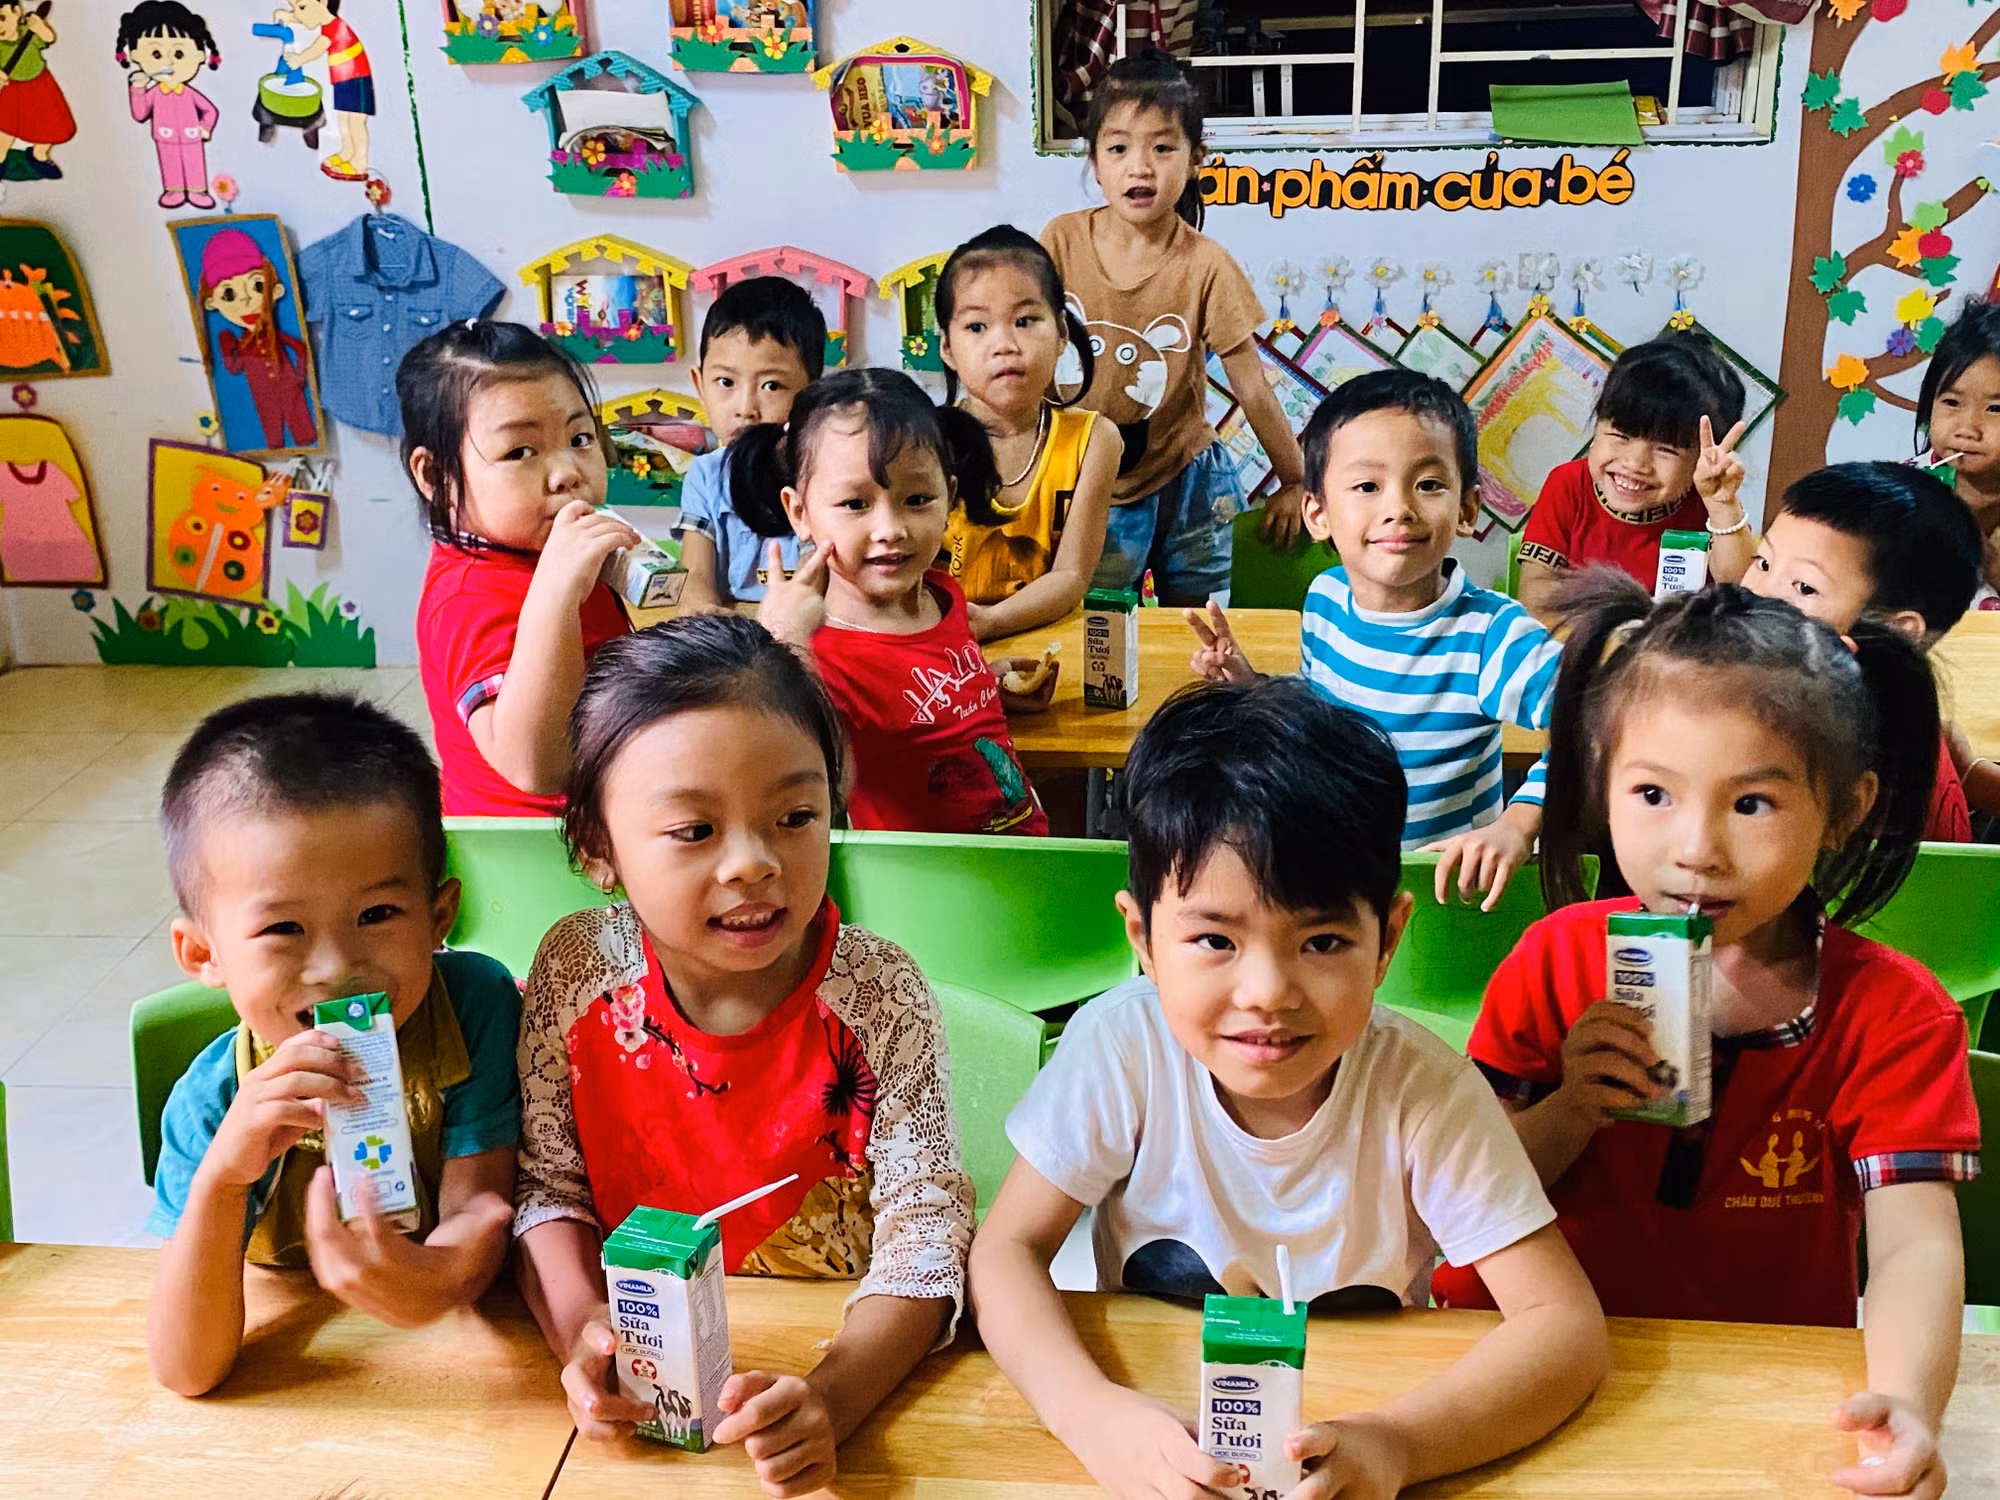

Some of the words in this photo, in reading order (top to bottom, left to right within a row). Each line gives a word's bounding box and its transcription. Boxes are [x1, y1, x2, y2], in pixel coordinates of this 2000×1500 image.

[1199, 156, 1259, 204] ản
[1272, 151, 1419, 218] phẩm
[1434, 152, 1541, 210] của
[1559, 148, 1633, 205] bé
[1089, 629, 1108, 637] 100%
[618, 1281, 654, 1293] VINAMILK
[620, 1301, 658, 1317] 100%
[620, 1316, 650, 1331] Sữa
[621, 1330, 663, 1349] Tươi
[1215, 1380, 1257, 1388] VINAMILK
[1214, 1400, 1259, 1414] 100%
[1211, 1416, 1247, 1431] Sữa
[1211, 1431, 1262, 1448] Tươi
